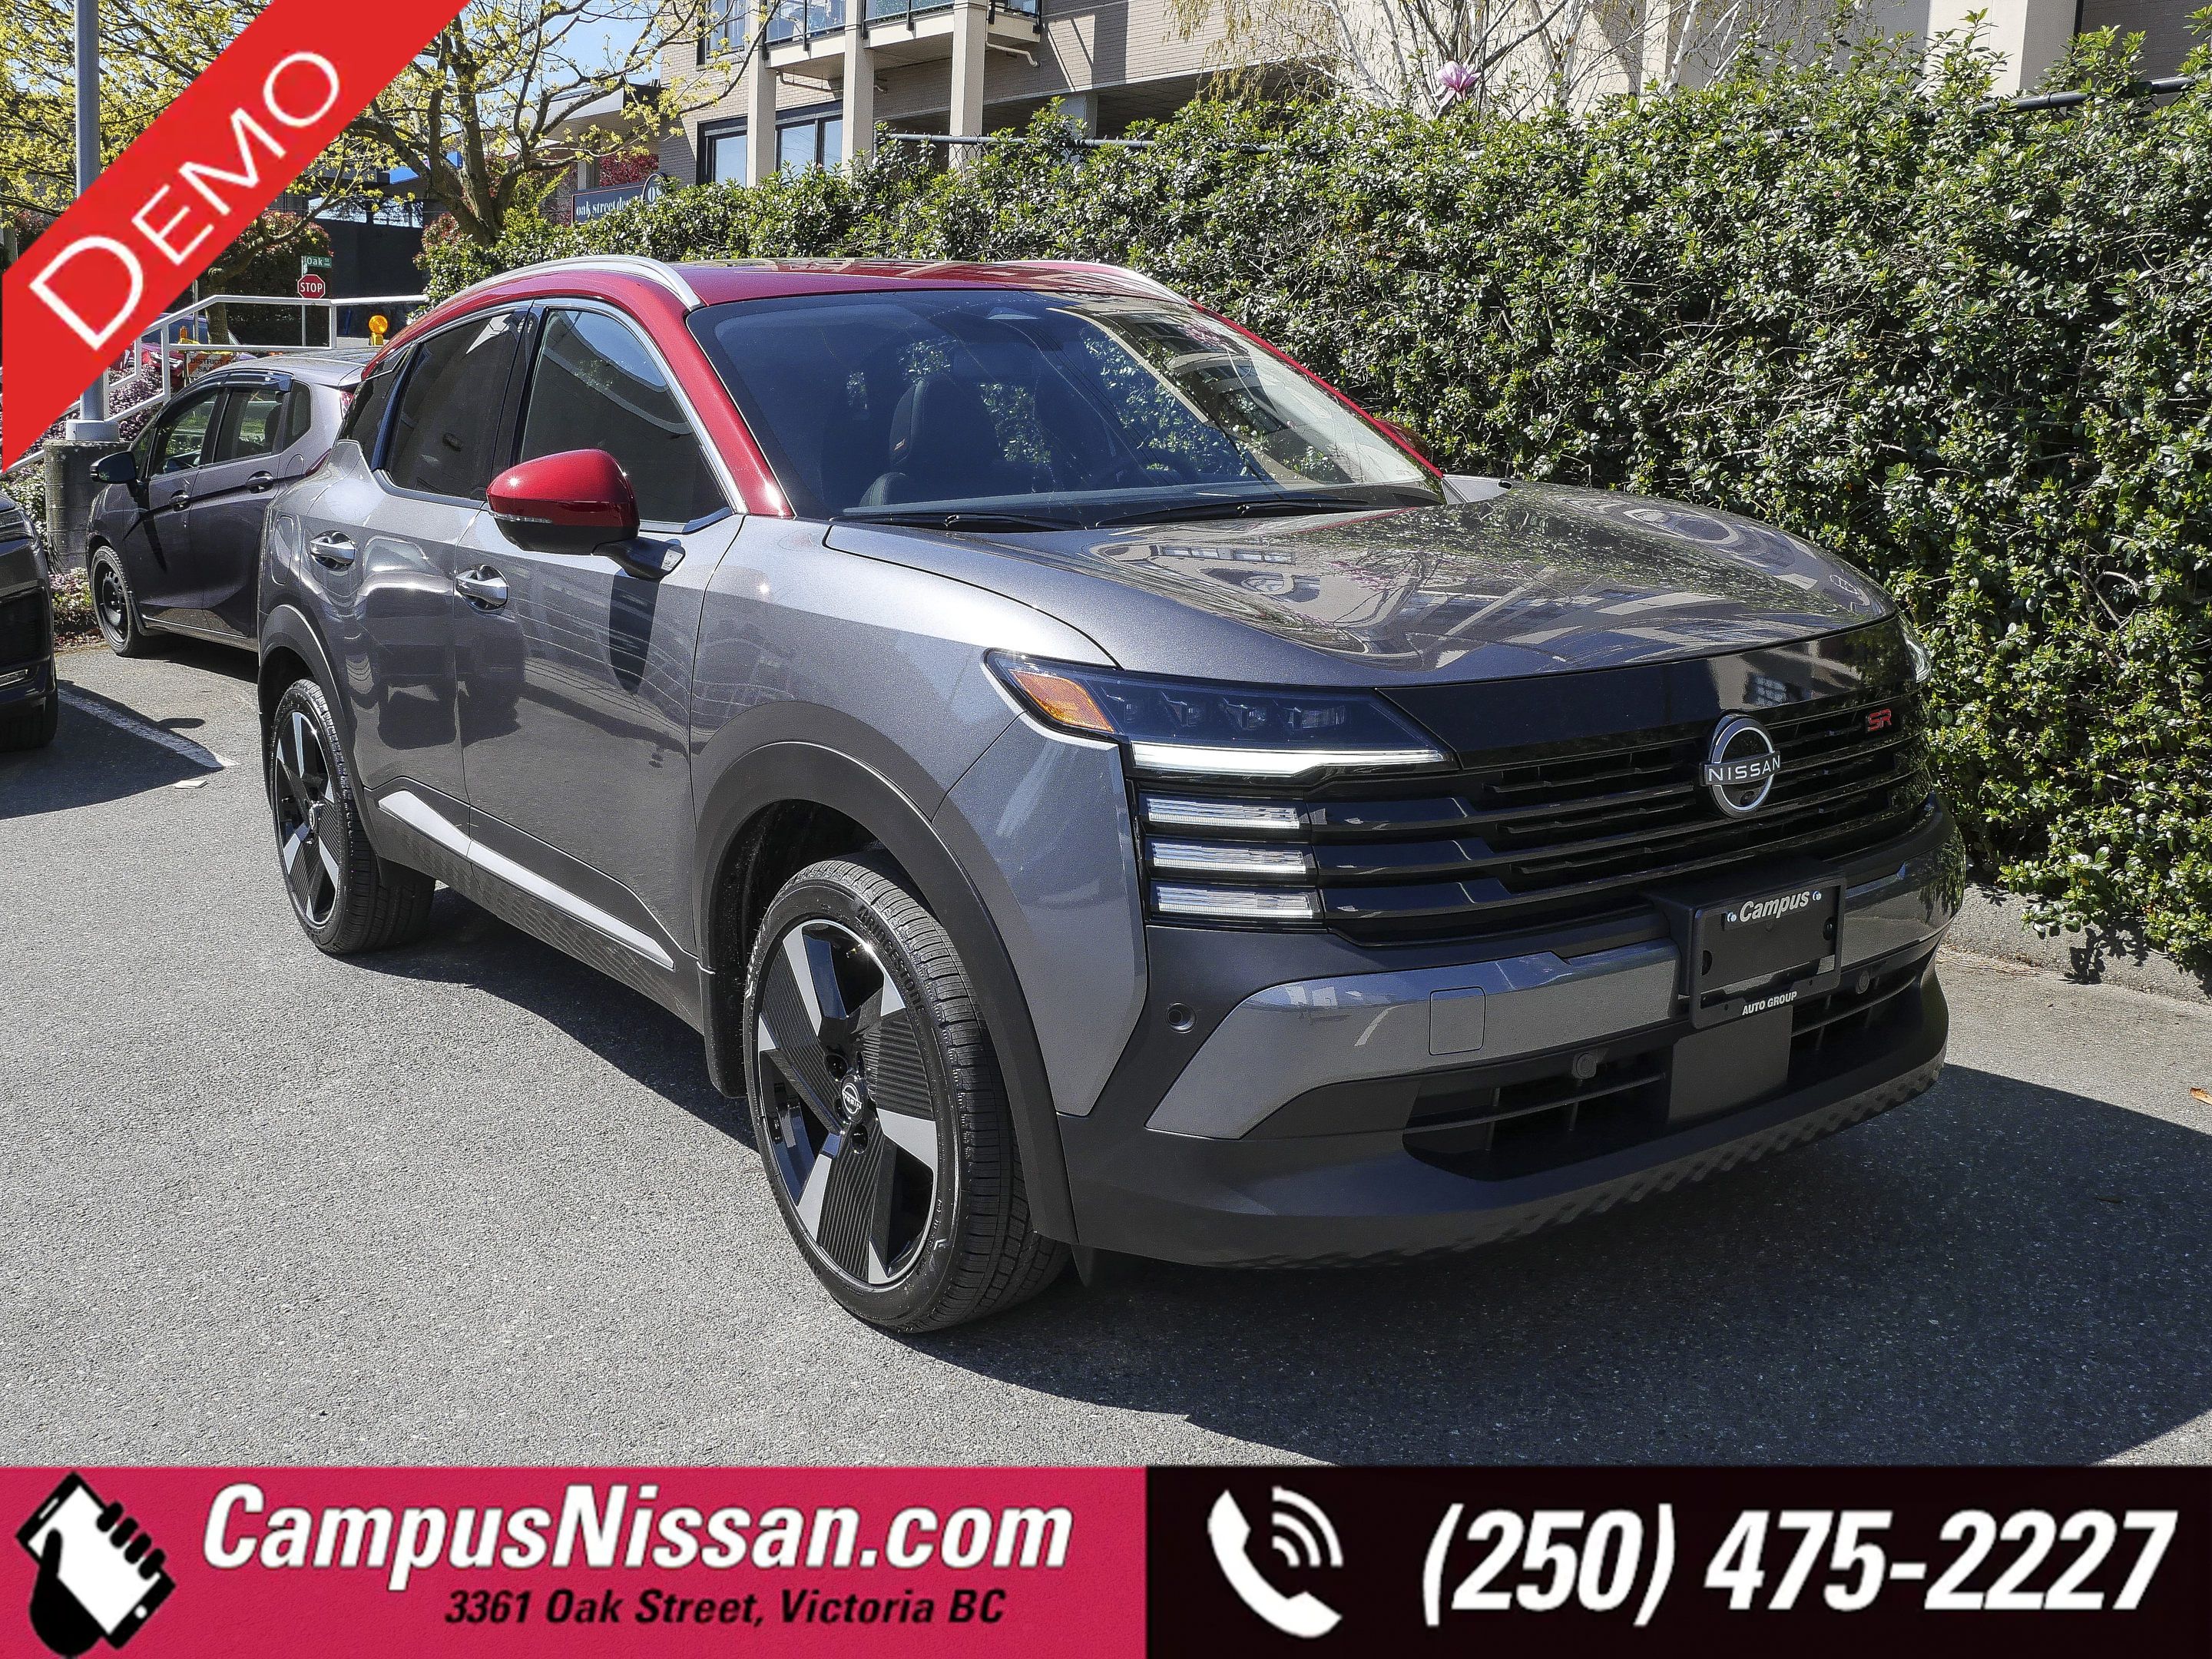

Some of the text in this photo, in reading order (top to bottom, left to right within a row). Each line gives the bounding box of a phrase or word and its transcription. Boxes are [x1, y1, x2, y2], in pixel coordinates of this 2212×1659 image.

[576, 200, 591, 217] oak
[592, 200, 616, 214] street
[307, 257, 323, 266] Oak
[300, 282, 323, 293] STOP
[1868, 708, 1892, 731] SR
[1708, 754, 1780, 782] NISSAN
[1740, 891, 1810, 922] Campus
[1742, 991, 1797, 1015] AUTO GROUP
